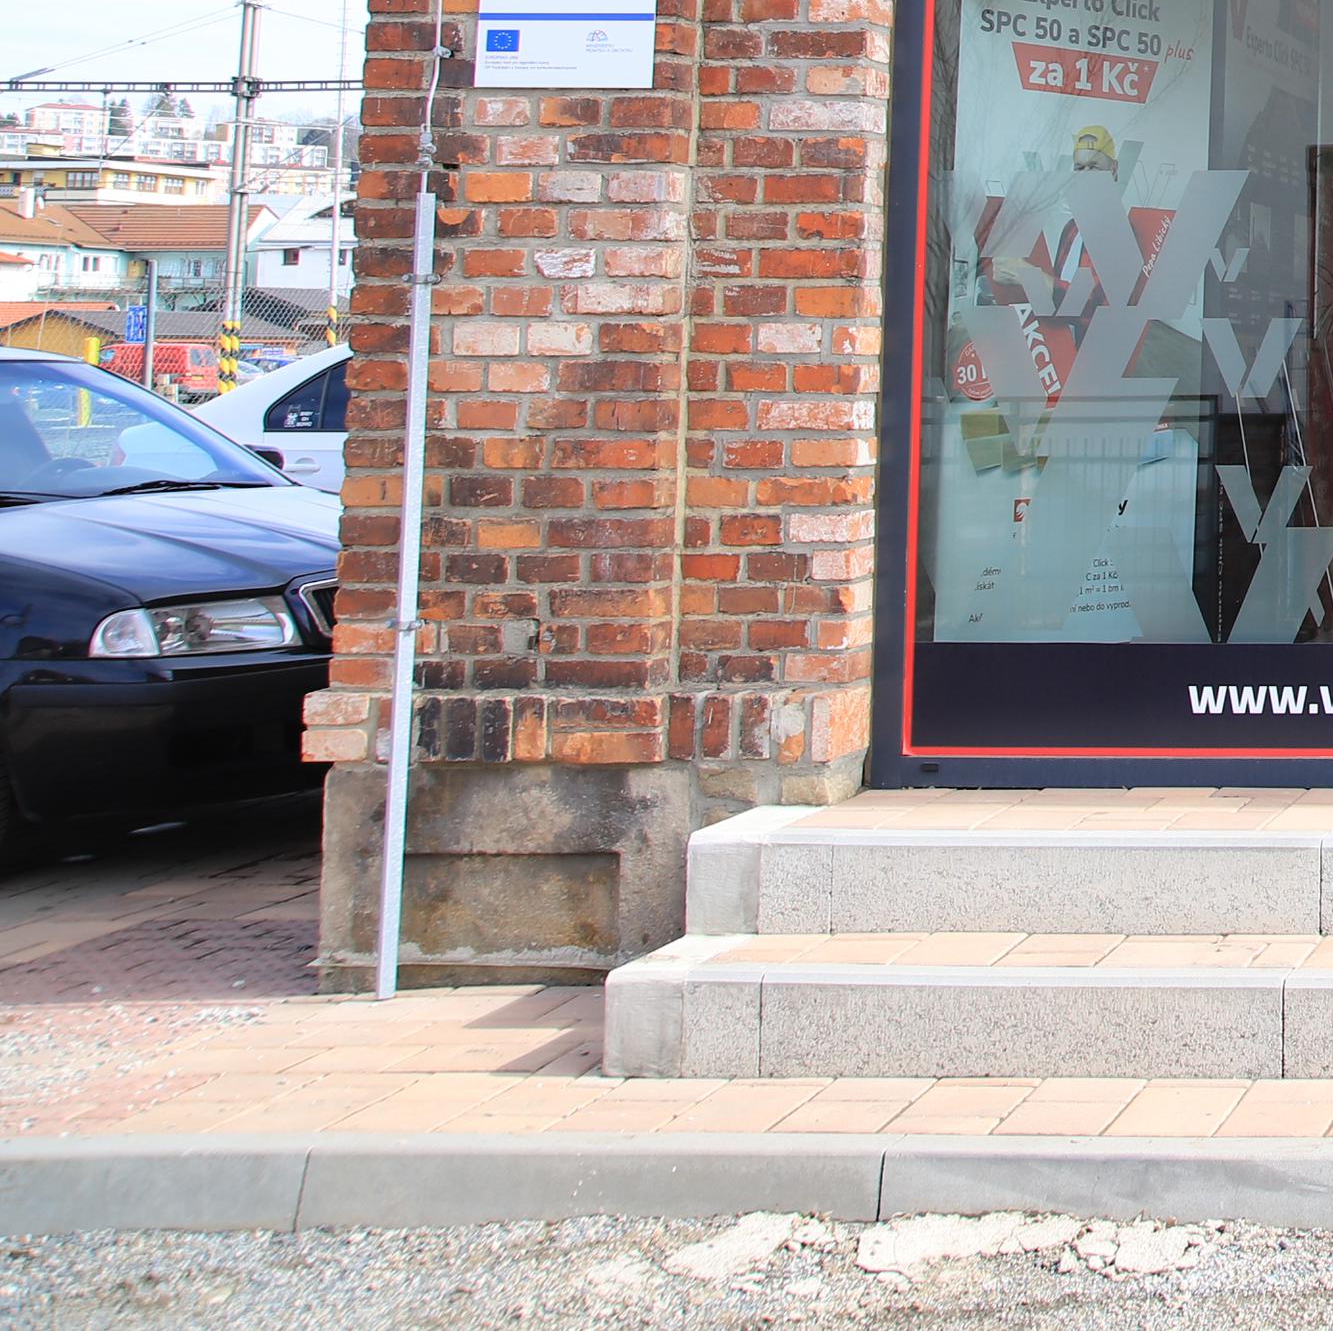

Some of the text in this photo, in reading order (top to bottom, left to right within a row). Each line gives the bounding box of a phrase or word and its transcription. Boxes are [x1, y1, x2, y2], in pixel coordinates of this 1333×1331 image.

[980, 9, 1194, 62] SPC 50 a SPC 50 plus
[1028, 59, 1064, 87] za
[1074, 58, 1092, 90] 1
[957, 365, 977, 384] 30
